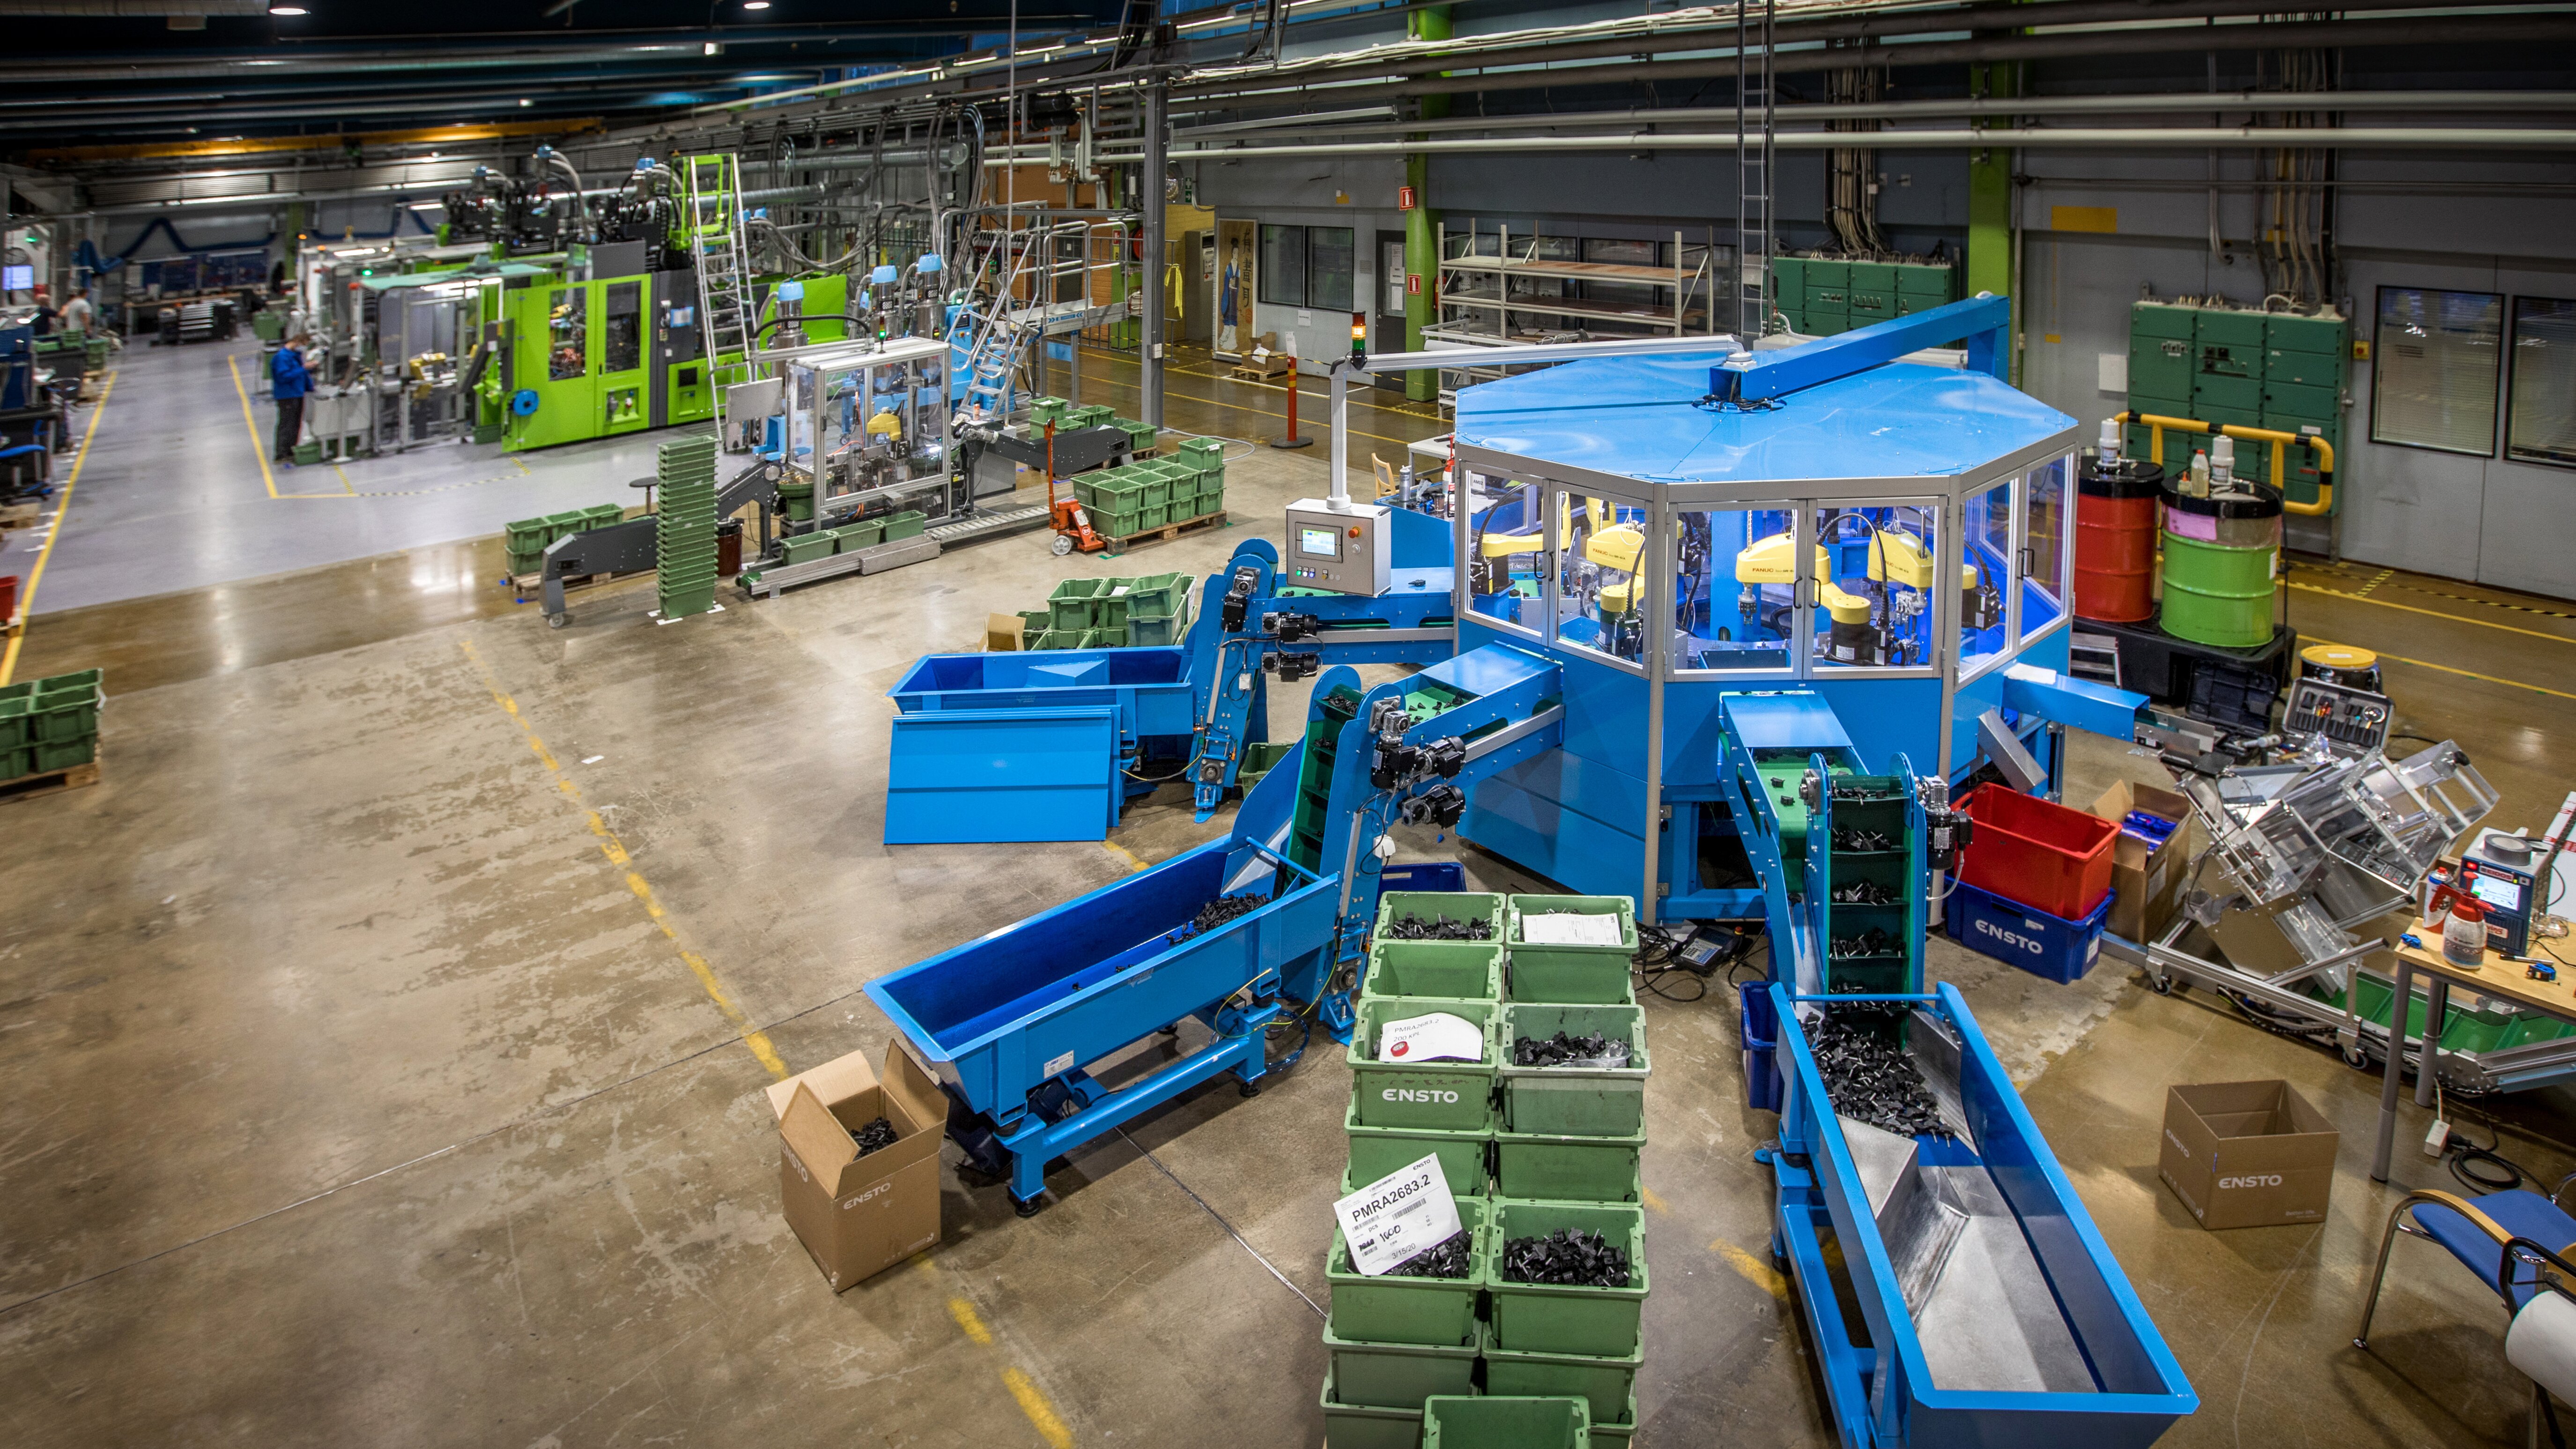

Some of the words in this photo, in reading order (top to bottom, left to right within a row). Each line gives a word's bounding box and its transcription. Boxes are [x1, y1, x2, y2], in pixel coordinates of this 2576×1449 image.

[2487, 869, 2511, 880] EIDOS
[1975, 919, 2043, 954] ENSTO
[1394, 1019, 1439, 1033] PMRA2683.2
[1382, 1088, 1459, 1103] ENSTO
[2166, 1129, 2190, 1158] ENSTO
[780, 1138, 808, 1183] ENSTO
[1413, 1159, 1431, 1171] ENSTO
[2219, 1174, 2282, 1189] ENSTO
[843, 1182, 891, 1210] ENSTO
[1352, 1174, 1431, 1222] PMRA2683.2
[1368, 1224, 1378, 1233] pcs
[1379, 1225, 1401, 1242] 1000
[1392, 1242, 1416, 1260] 3/15/20
